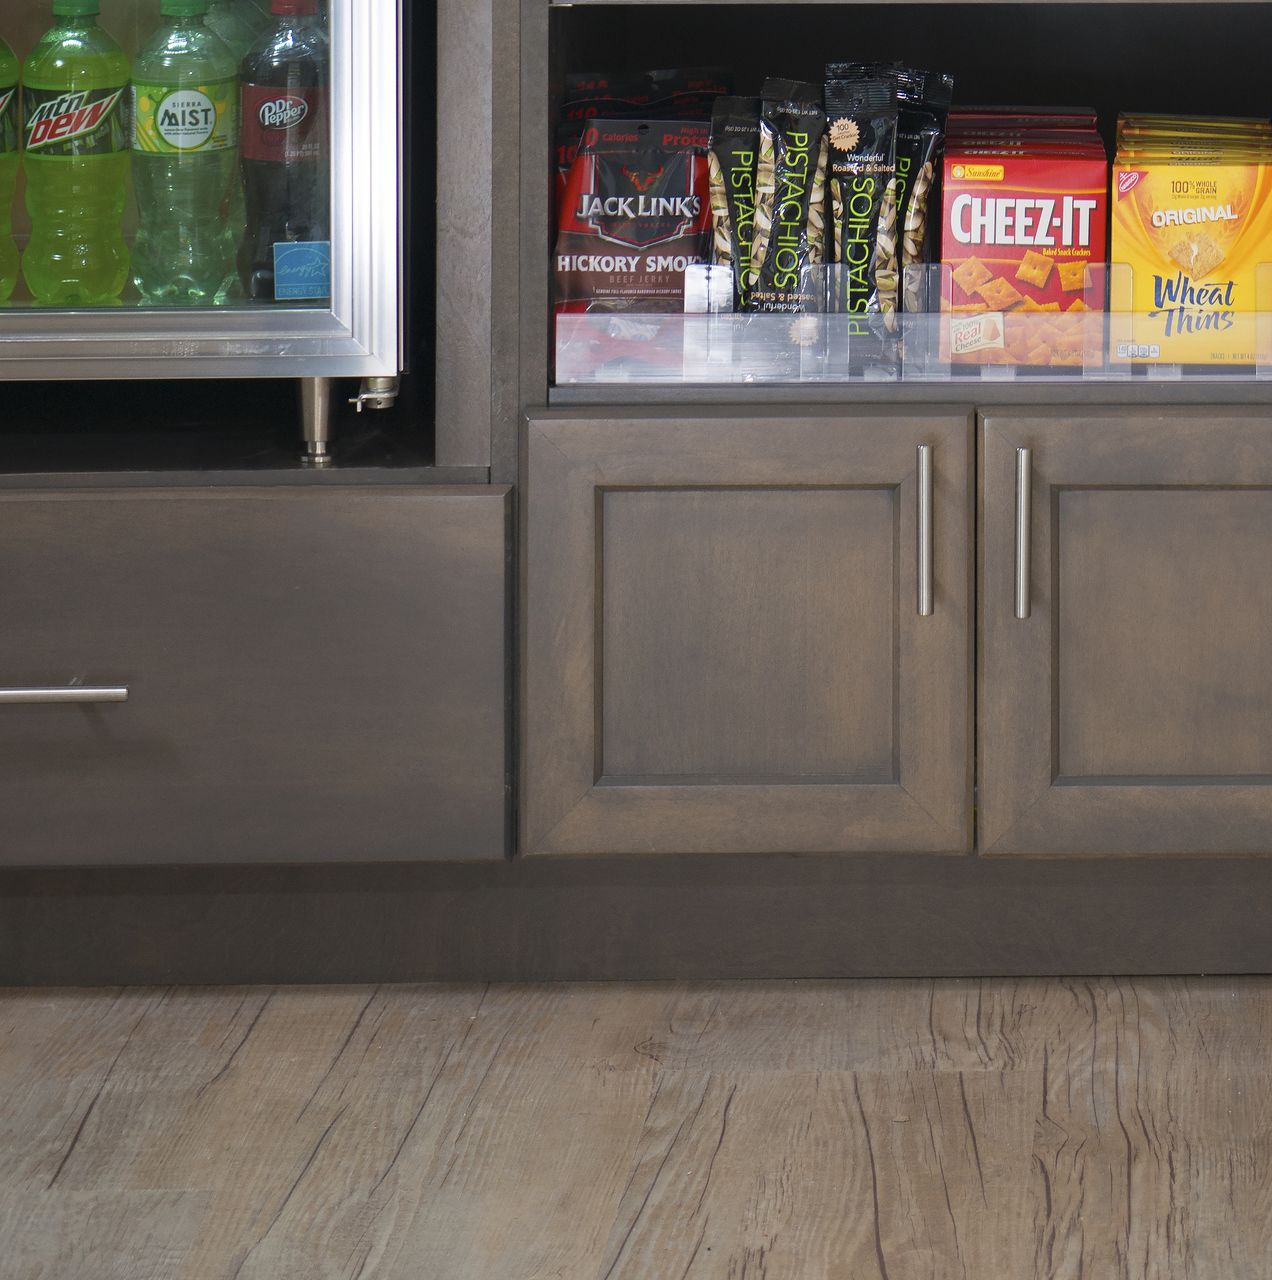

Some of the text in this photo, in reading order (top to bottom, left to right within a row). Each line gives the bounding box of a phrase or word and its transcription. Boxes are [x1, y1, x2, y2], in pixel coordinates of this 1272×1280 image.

[172, 101, 202, 109] SIERRA
[275, 99, 294, 114] Dr
[159, 108, 212, 127] MIST
[264, 100, 306, 127] Pepper
[836, 122, 850, 132] 100
[602, 132, 640, 143] Calories
[847, 152, 885, 162] Wonderful
[966, 166, 1001, 178] Sunshine
[1171, 180, 1218, 194] 100% WHOLE
[1195, 187, 1218, 195] GRAIN
[576, 194, 701, 220] JACK LINK'S
[774, 131, 809, 289] PISTACHIOS
[950, 193, 1098, 247] CHEEZ-IT
[1151, 203, 1240, 228] ORIGINAL
[846, 177, 876, 336] PISTACHIOS
[1042, 247, 1091, 257] Baked Snack Crackers
[557, 254, 642, 273] HICKORY
[609, 274, 671, 284] BEEF JERKY
[1152, 270, 1239, 310] Wheat
[763, 302, 806, 313] Wonderful
[1148, 306, 1235, 338] Thins
